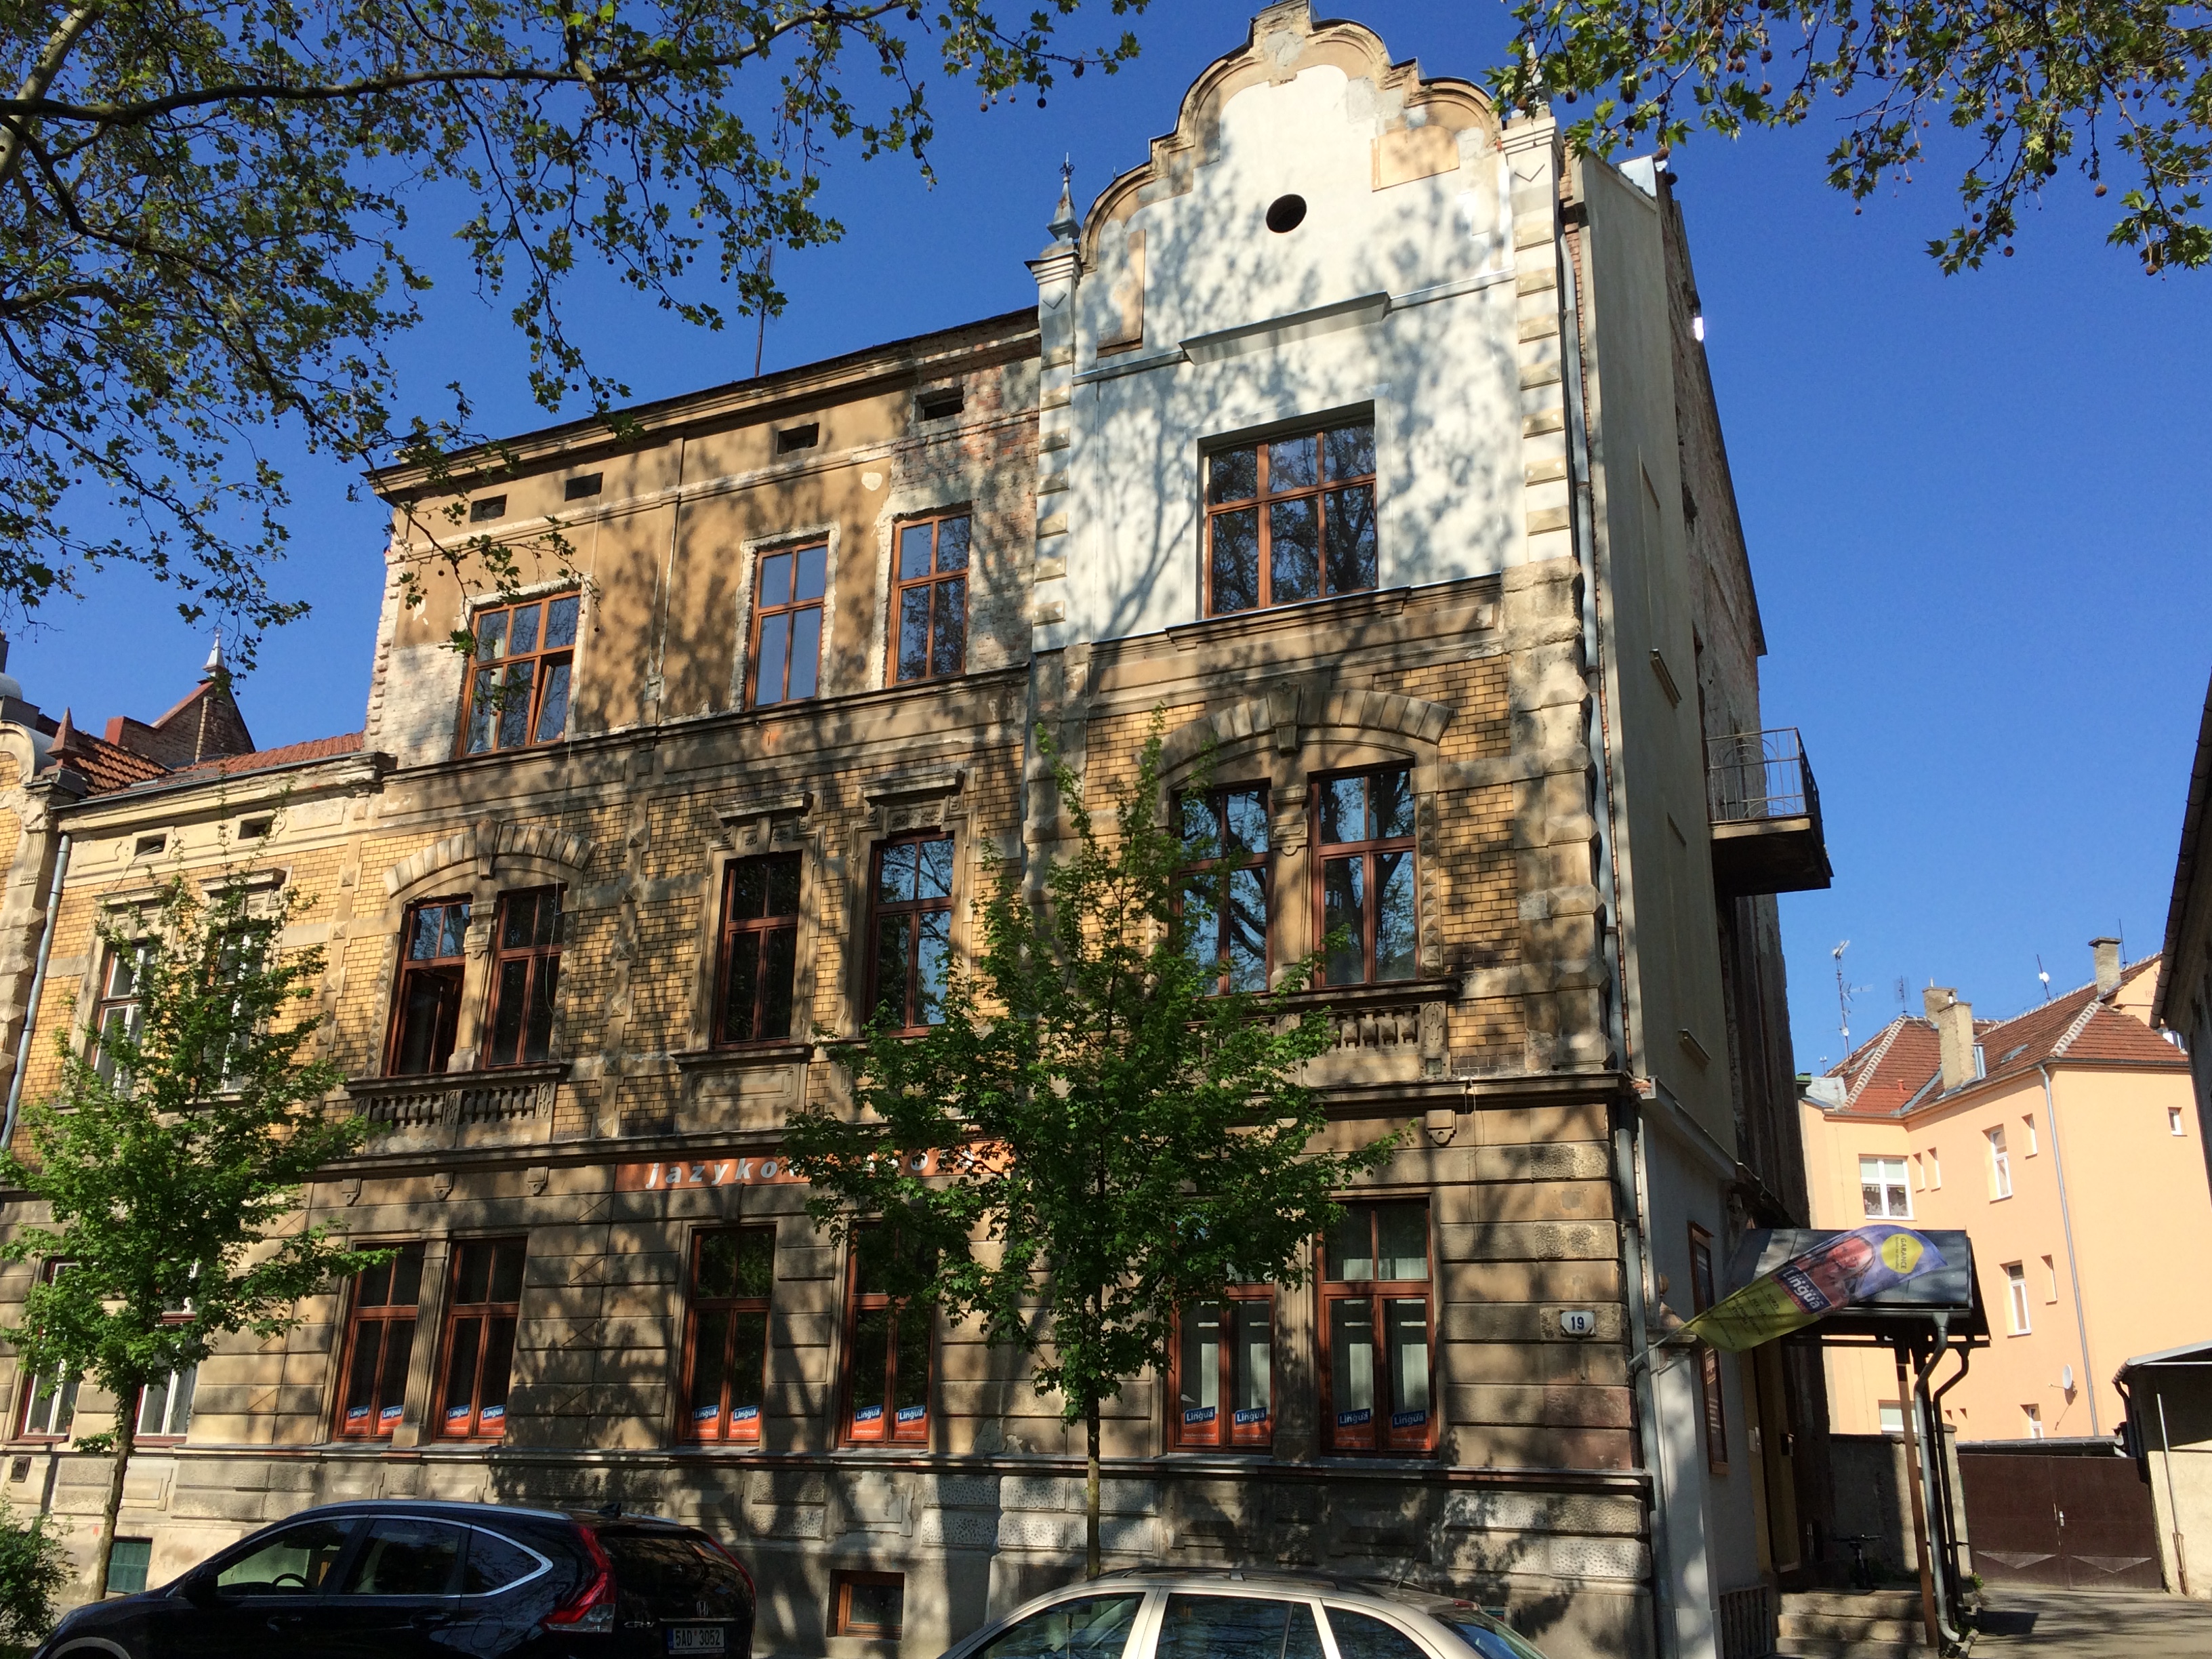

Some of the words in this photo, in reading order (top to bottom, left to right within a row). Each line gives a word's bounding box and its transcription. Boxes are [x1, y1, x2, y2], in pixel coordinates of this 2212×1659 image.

[645, 1158, 805, 1189] jazyko
[1782, 1269, 1820, 1309] Lingua
[1571, 1315, 1585, 1330] 19
[449, 1408, 468, 1417] Lingua
[484, 1408, 504, 1418] Lingua
[695, 1408, 717, 1418] Lingua
[735, 1408, 756, 1419] Lingua
[857, 1408, 880, 1419] Lingua
[899, 1409, 923, 1420] Lingua
[1187, 1410, 1214, 1422] Lingua
[1237, 1411, 1265, 1422] Lingua
[1340, 1412, 1369, 1425] Lingua
[1394, 1414, 1424, 1425] Lingua
[676, 1630, 693, 1647] 5AD
[699, 1629, 720, 1646] 3052
